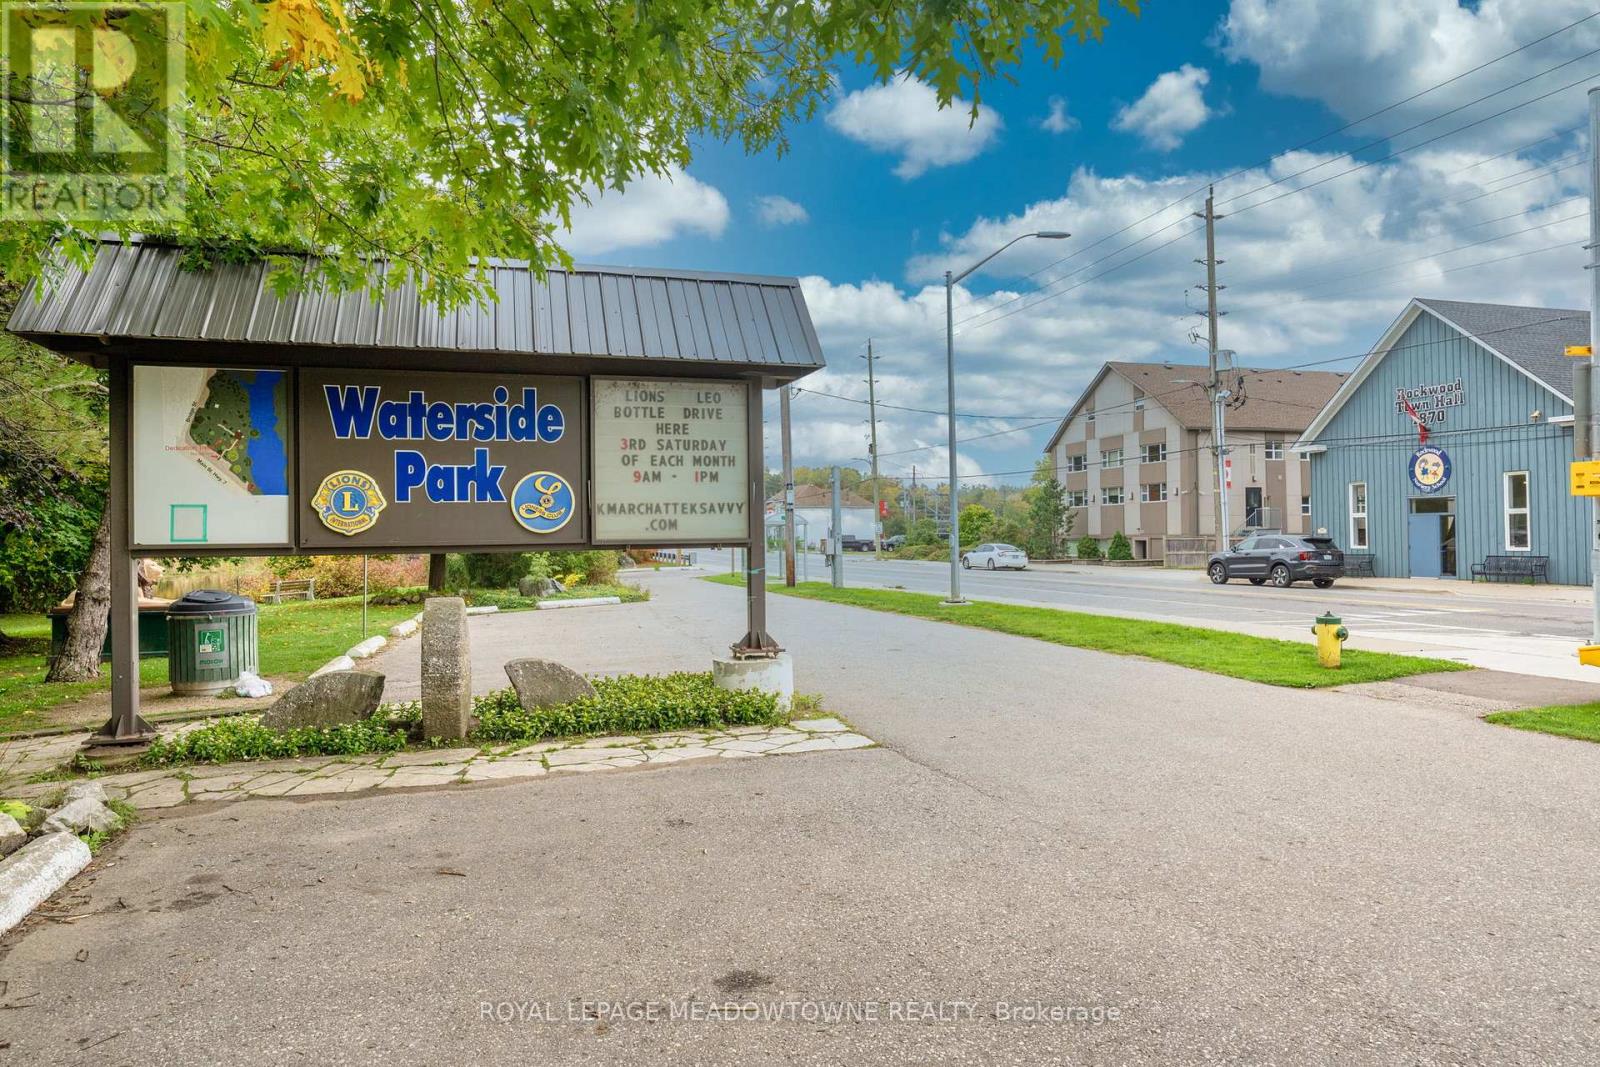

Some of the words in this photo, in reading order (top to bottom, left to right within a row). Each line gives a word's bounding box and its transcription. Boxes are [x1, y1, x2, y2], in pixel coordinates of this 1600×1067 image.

[1395, 378, 1462, 400] Rockwood
[625, 390, 665, 403] LIONS
[697, 391, 722, 404] LEO
[1434, 391, 1465, 408] Hall
[323, 385, 565, 442] Waterside
[614, 406, 665, 419] BOTTLE
[683, 407, 723, 420] DRIVE
[1413, 409, 1446, 425] 870
[656, 423, 690, 435] HERE
[620, 438, 647, 451] 3RD
[657, 439, 727, 451] SATURDAY
[621, 454, 639, 466] OF
[650, 455, 684, 467] EACH
[692, 455, 736, 467] MONTH
[329, 475, 369, 488] LIONS
[394, 447, 507, 503] Park
[633, 470, 662, 483] 9AM
[342, 491, 360, 512] L
[329, 517, 369, 528] INTERNATIONAL
[645, 518, 678, 531] .COM
